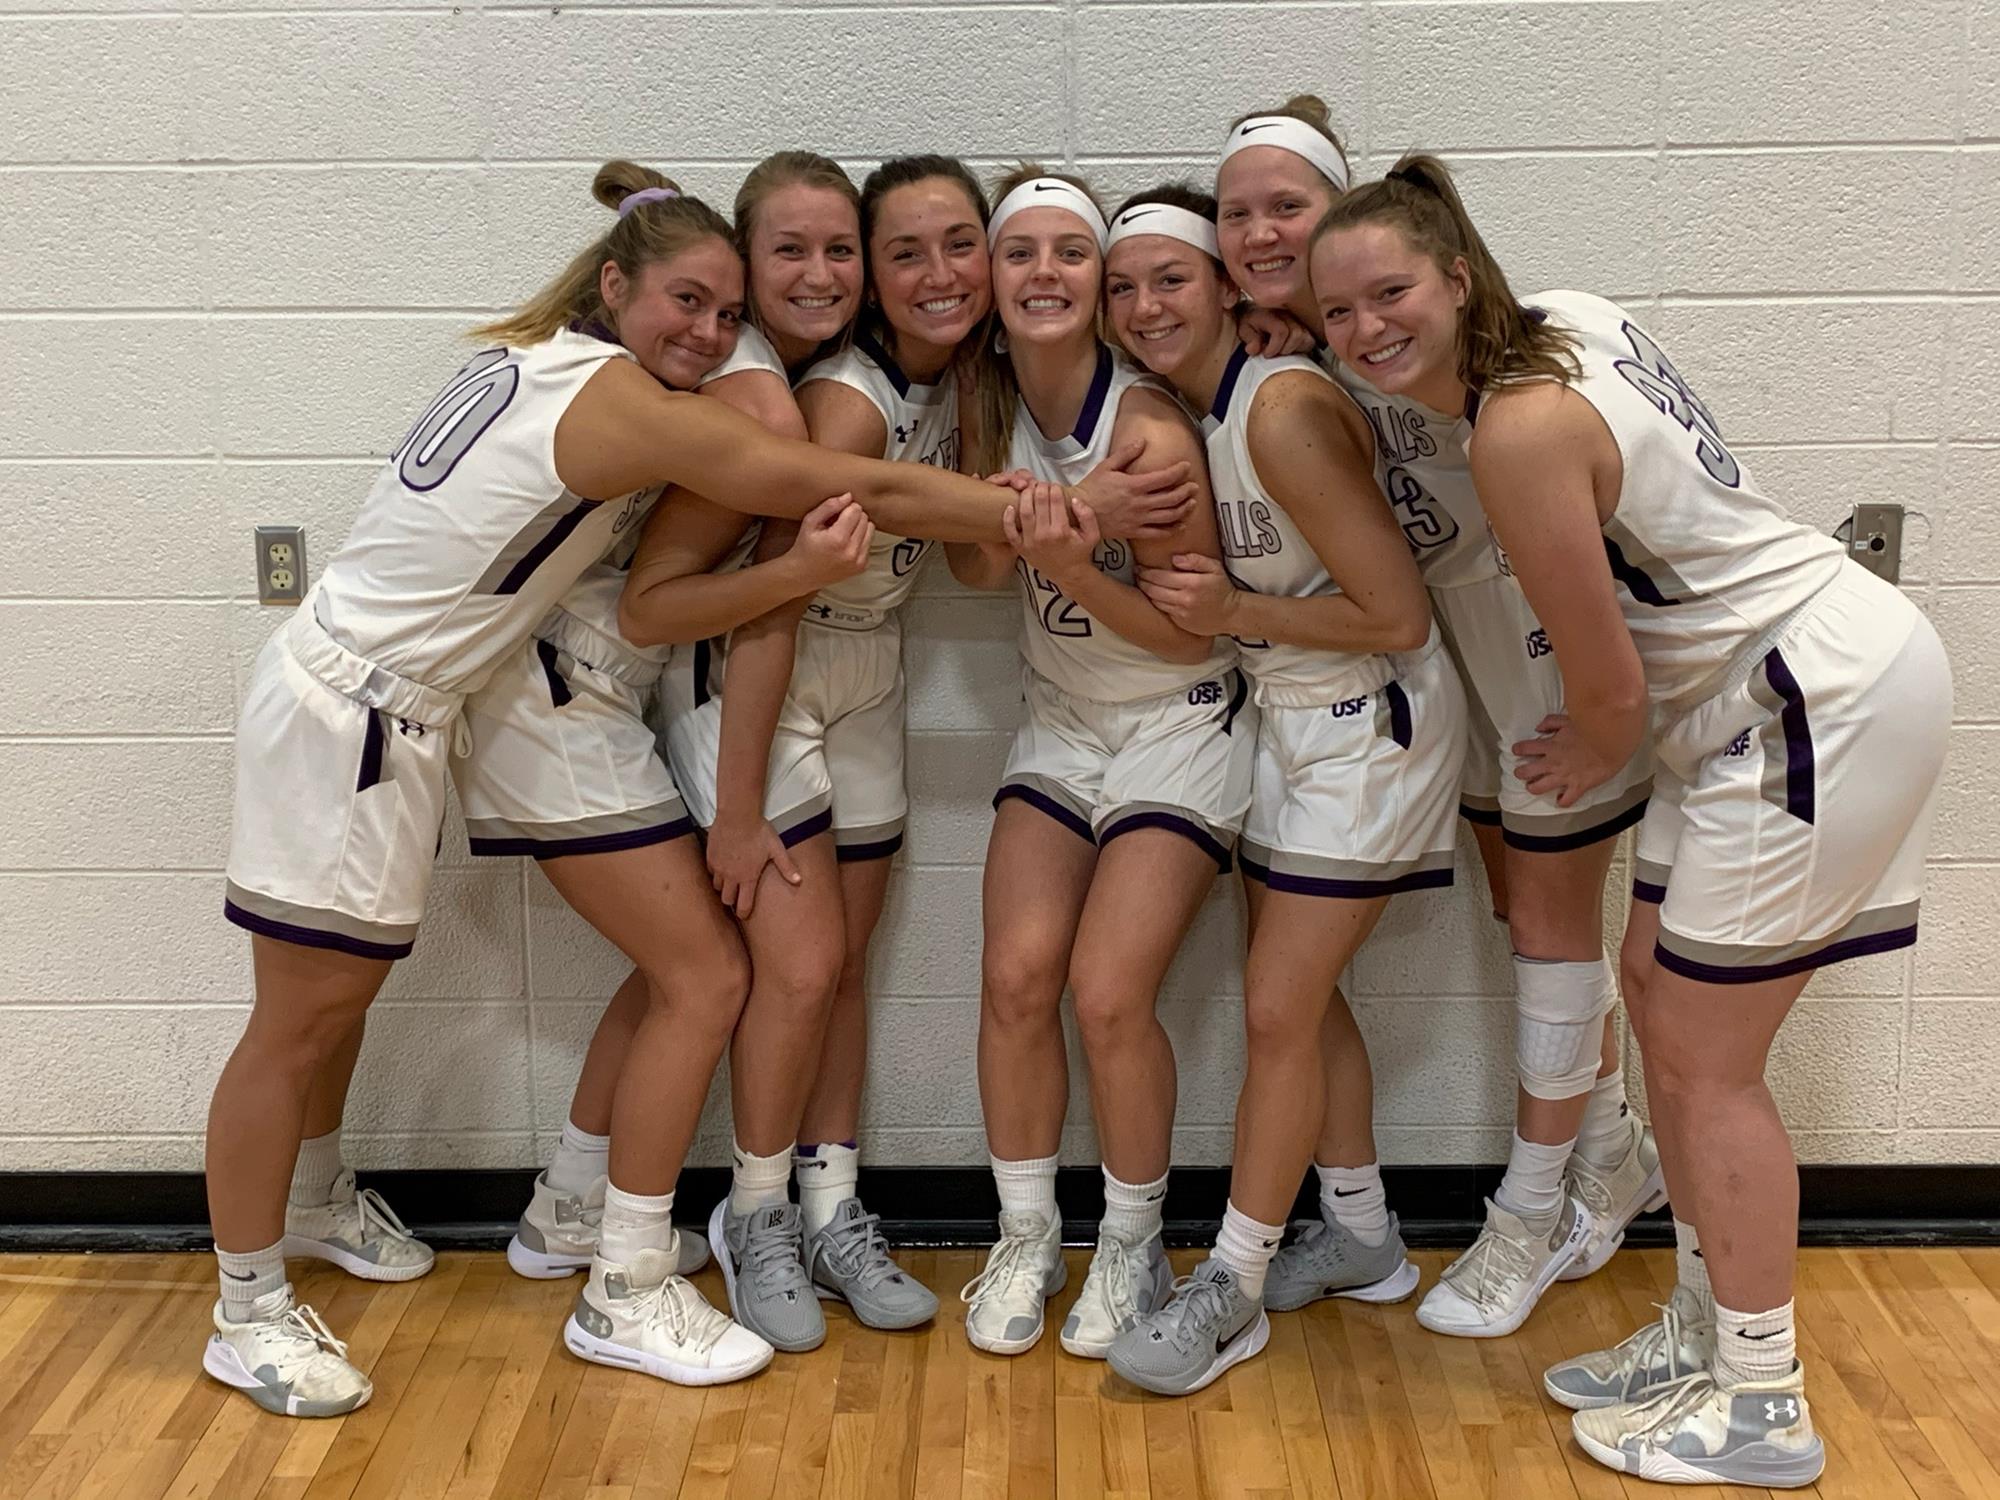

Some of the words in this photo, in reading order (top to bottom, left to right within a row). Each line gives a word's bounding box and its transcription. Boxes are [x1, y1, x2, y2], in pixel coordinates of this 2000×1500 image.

[1221, 500, 1282, 558] LLS
[1527, 637, 1554, 659] US
[1188, 685, 1223, 705] USF
[1332, 696, 1368, 718] USF
